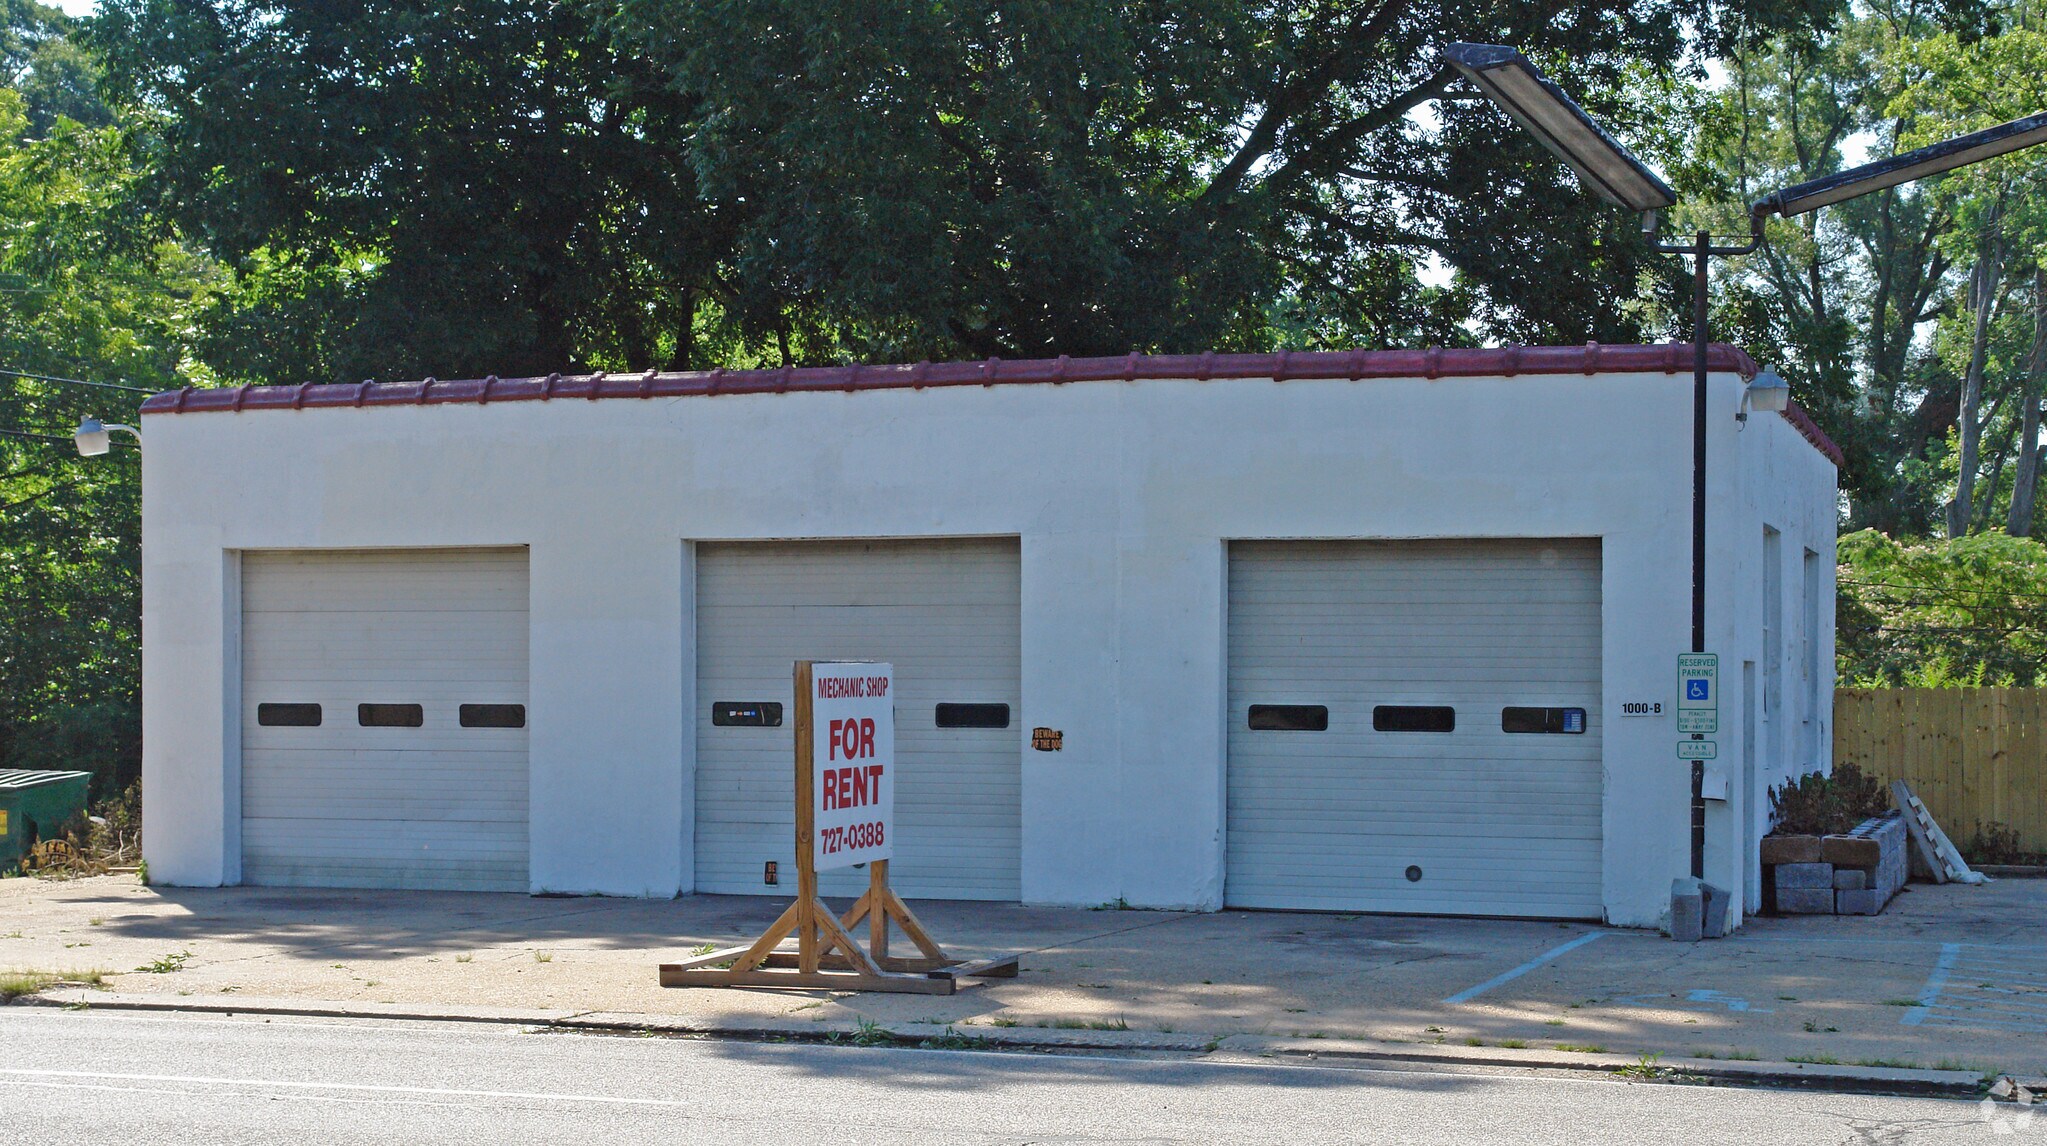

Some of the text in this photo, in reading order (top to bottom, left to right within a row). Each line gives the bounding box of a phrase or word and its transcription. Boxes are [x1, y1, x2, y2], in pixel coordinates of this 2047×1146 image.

[1679, 658, 1716, 667] RESERVED
[1682, 669, 1713, 677] PARKING
[818, 676, 888, 699] MECHANIC SHOP
[1622, 702, 1661, 714] 1000-B
[829, 717, 875, 761] FOR
[1034, 729, 1060, 739] BEWARE
[1040, 739, 1050, 748] THE
[823, 765, 884, 811] RENT
[821, 821, 884, 855] 727-0388
